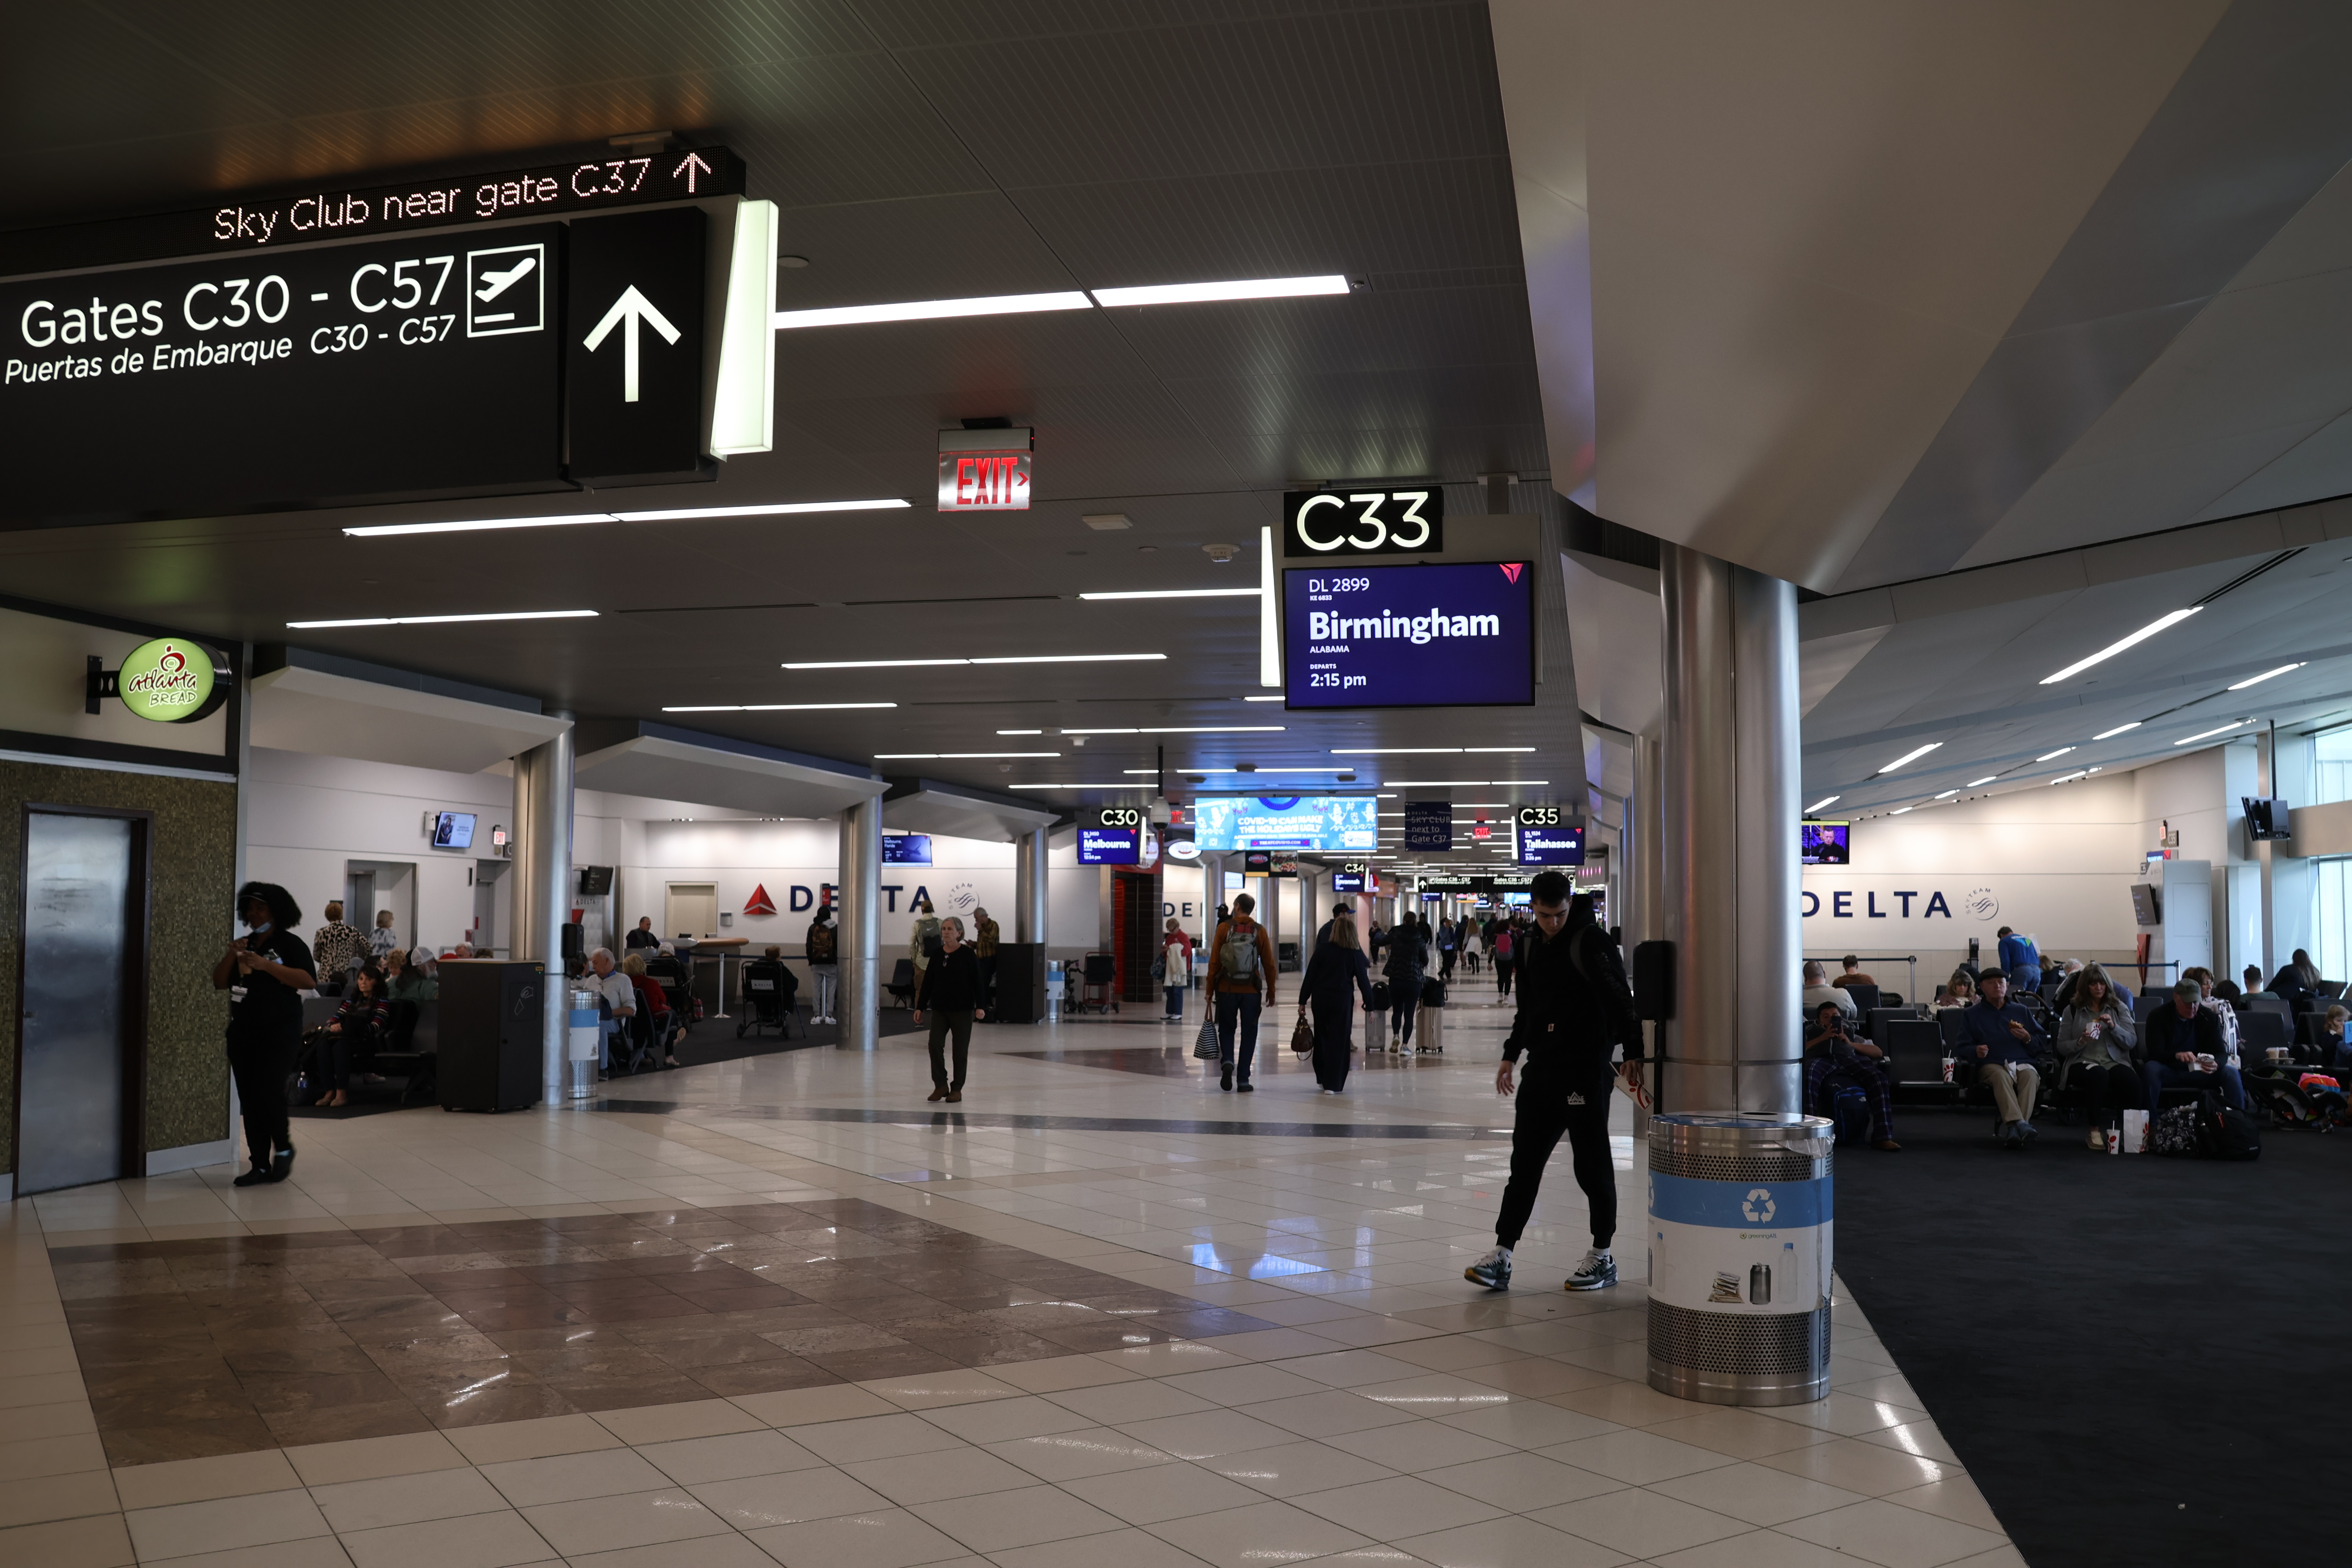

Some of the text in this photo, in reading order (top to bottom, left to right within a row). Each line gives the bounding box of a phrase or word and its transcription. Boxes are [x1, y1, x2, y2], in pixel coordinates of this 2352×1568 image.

[214, 157, 652, 243] Sky Club near gate C37
[22, 255, 454, 347] Gates C30 - C57
[5, 355, 103, 385] Puertas
[111, 347, 144, 374] de
[152, 338, 292, 370] Embarque
[310, 323, 368, 354] C30
[399, 314, 456, 345] C57
[956, 457, 1018, 505] EXIT
[1297, 492, 1430, 551] C33
[1309, 577, 1370, 592] DL 2899
[1310, 607, 1499, 644] Birmingham
[1310, 645, 1350, 653] ALABAMA
[1310, 673, 1367, 689] 2:15 pm
[149, 690, 197, 707] BREAD
[1100, 809, 1138, 826] C30
[1170, 811, 1183, 823] XIT
[1237, 817, 1278, 825] COVID-19
[1298, 815, 1324, 824] MAKE
[1520, 808, 1558, 824] C35
[1239, 824, 1321, 834] THE HOLIDAYS UGLY
[1474, 827, 1488, 838] EXIT
[496, 833, 504, 843] EXIT
[1083, 839, 1131, 849] Melbourne
[1524, 838, 1576, 849] Tallahassee
[1345, 864, 1365, 873] C34
[790, 886, 935, 913] DETA
[948, 882, 973, 910] SKYTEAM
[1965, 887, 1991, 915] SKYTEAM
